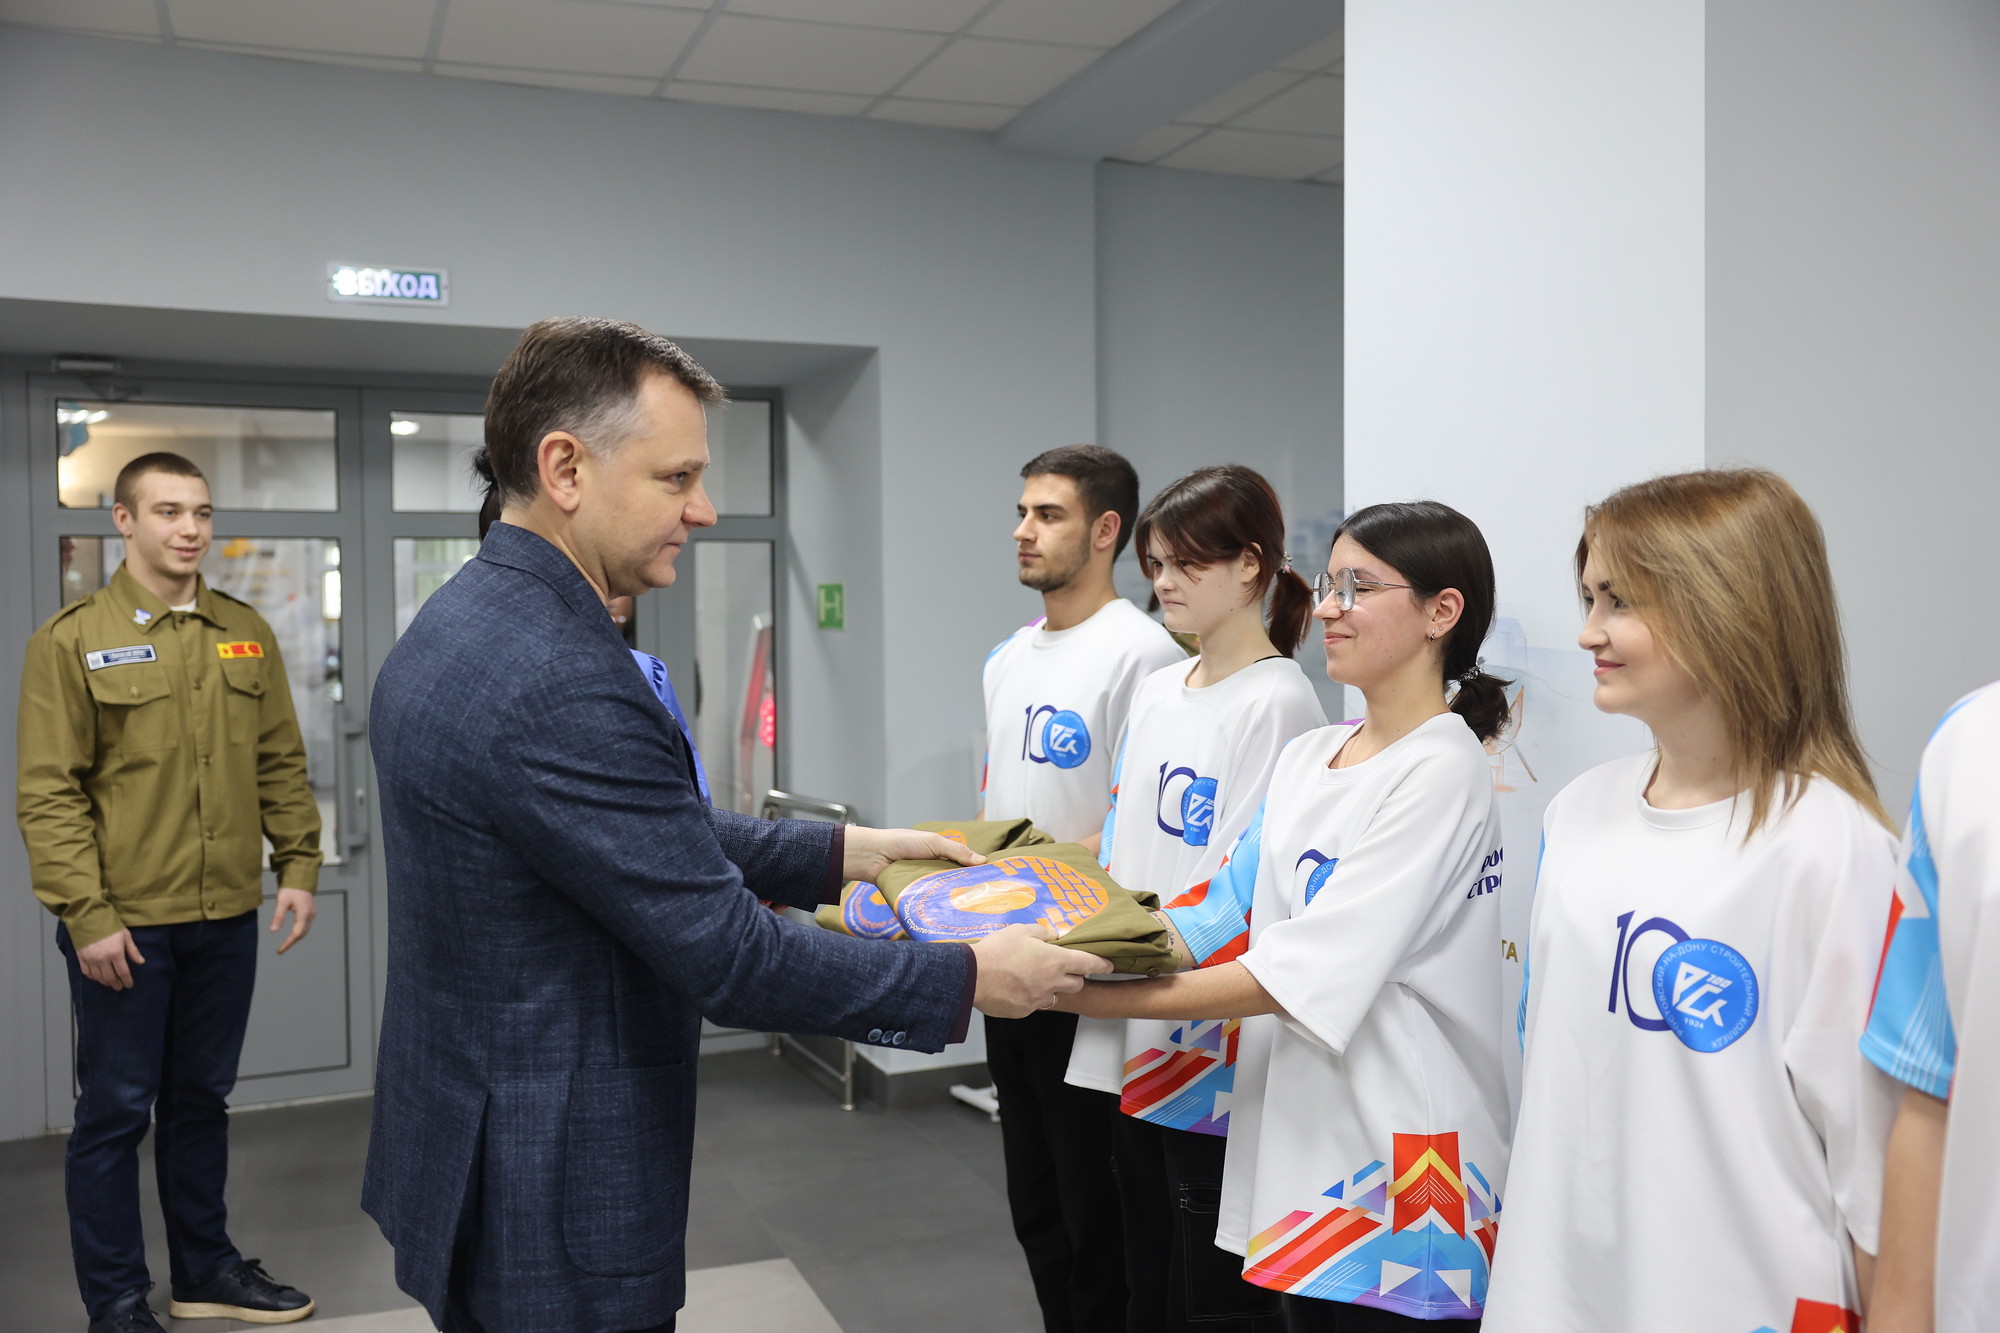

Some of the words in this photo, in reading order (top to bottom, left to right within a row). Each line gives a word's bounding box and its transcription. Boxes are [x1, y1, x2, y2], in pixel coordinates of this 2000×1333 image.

[335, 268, 439, 299] ВЫХОД
[1710, 944, 1755, 1017] СТРОИТЕЛЬНЫЙ
[1684, 1017, 1704, 1029] 1924
[1710, 1016, 1748, 1049] КОЛЛЕДЖ
